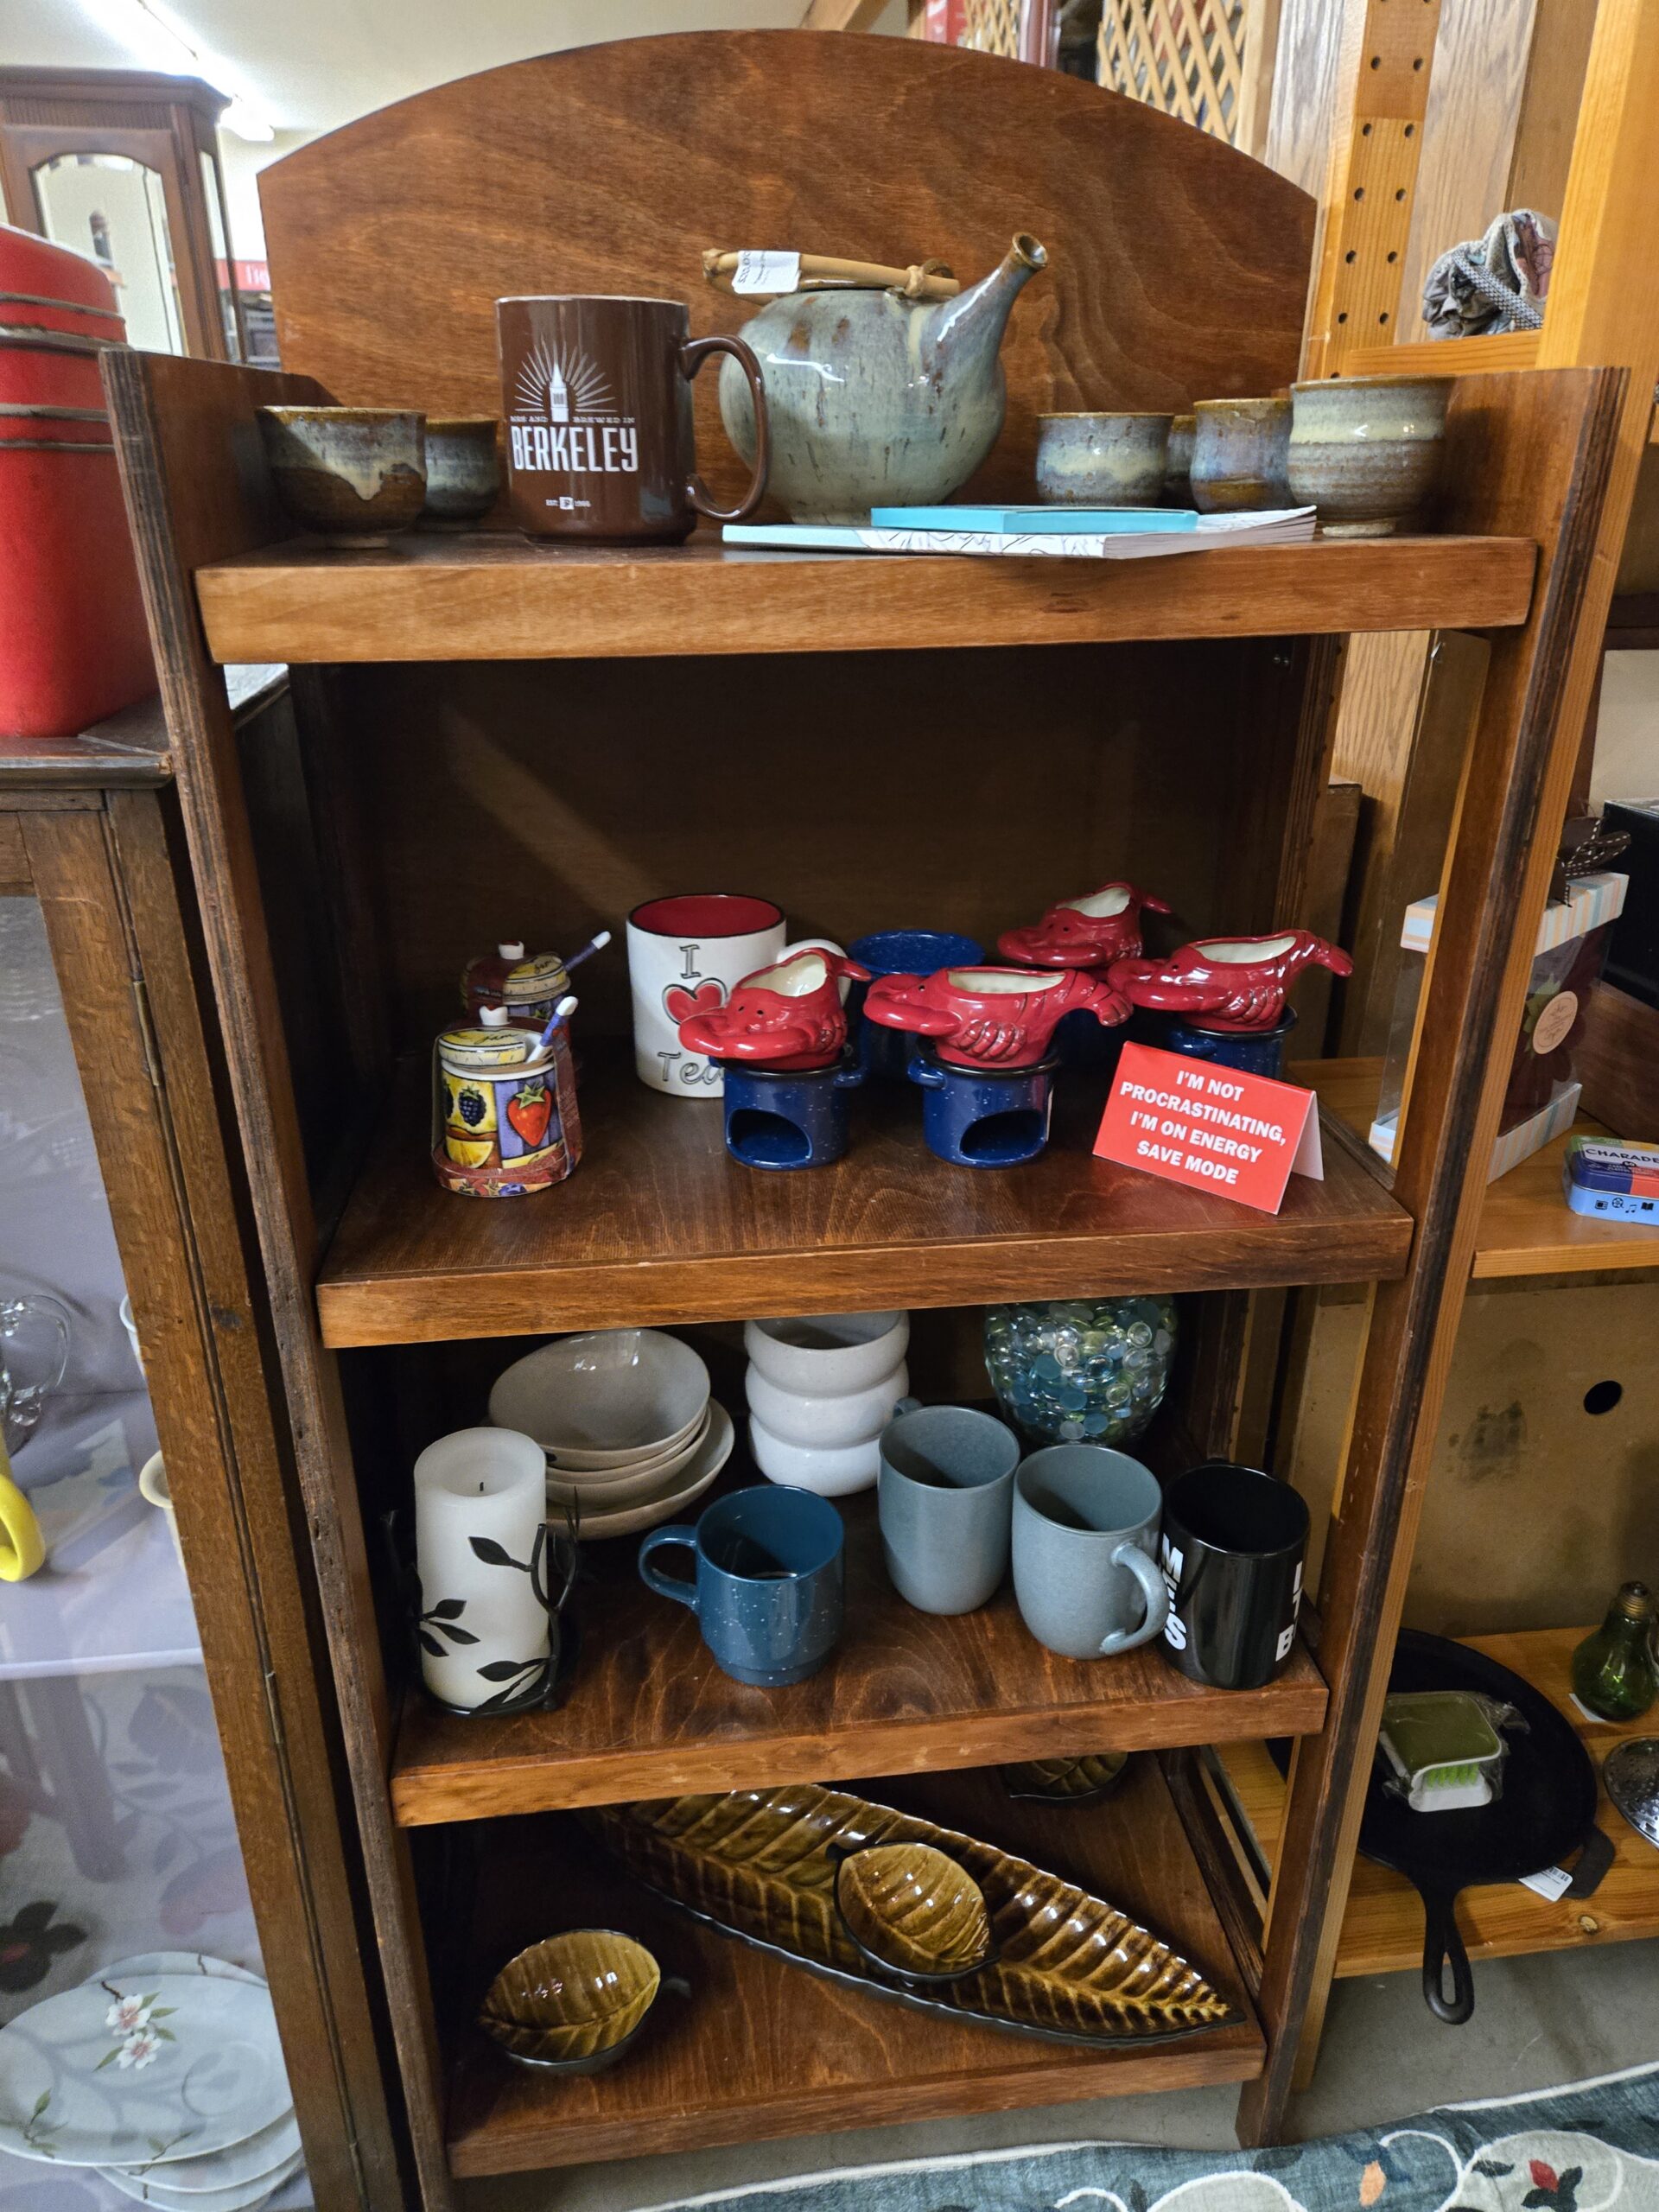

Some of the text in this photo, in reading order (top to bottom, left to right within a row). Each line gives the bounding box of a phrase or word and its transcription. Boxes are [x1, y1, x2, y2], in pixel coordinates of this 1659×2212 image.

[511, 426, 639, 472] BERKELEY
[679, 944, 702, 979] I
[1176, 1071, 1244, 1102] I'M NOT
[1120, 1082, 1287, 1146] PROCRASTINATING,
[1130, 1111, 1262, 1163] I'M ON ENERGY
[1136, 1141, 1239, 1185] SAVE MODE
